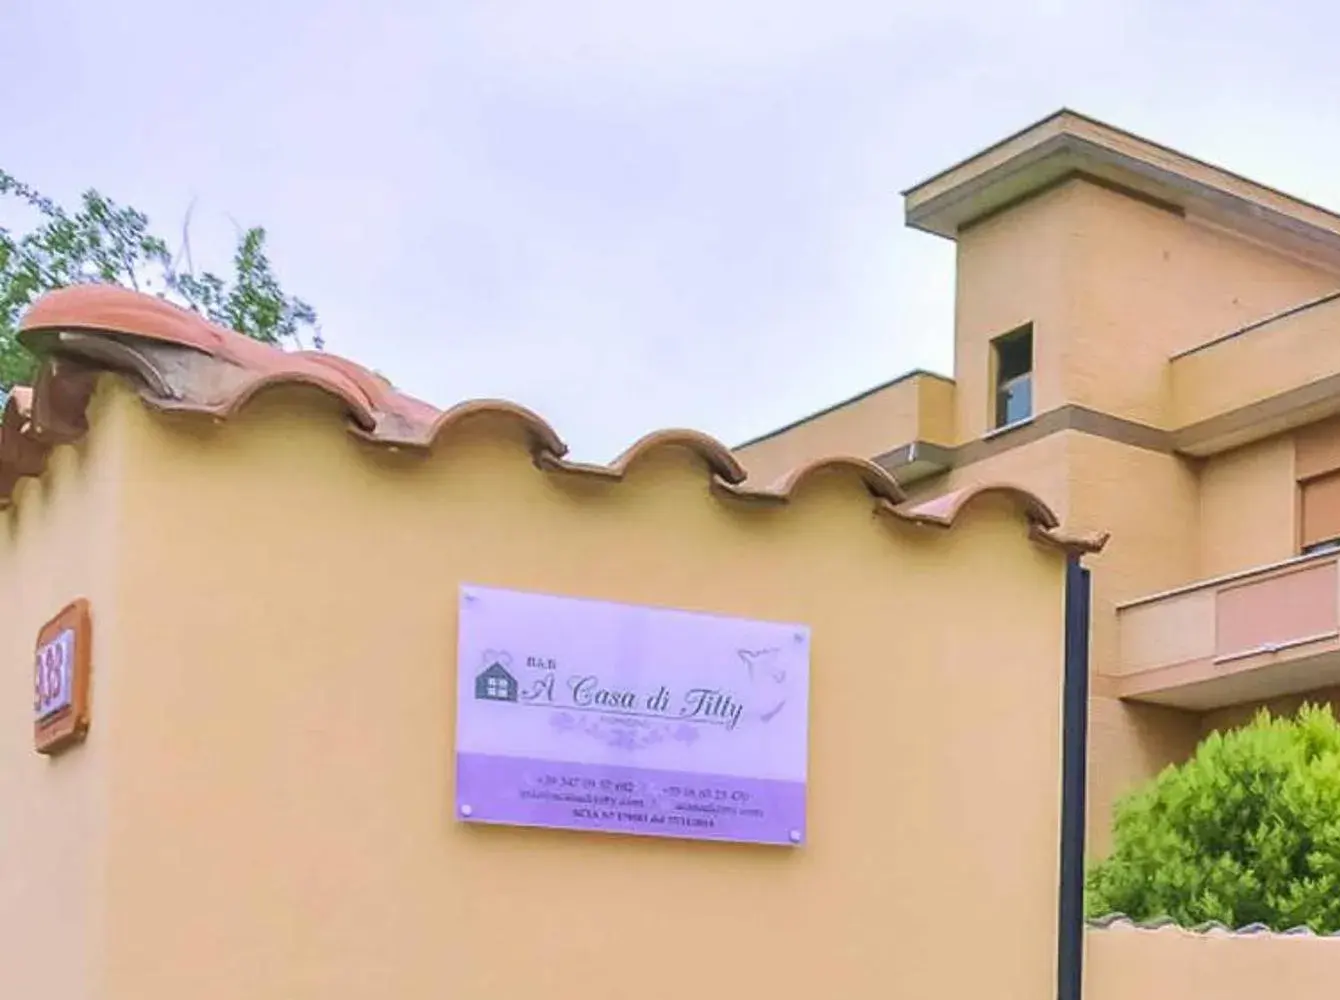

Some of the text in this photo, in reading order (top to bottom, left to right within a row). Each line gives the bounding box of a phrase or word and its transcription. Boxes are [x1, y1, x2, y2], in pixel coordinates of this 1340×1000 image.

[521, 672, 556, 702] A
[566, 675, 636, 707] Casa
[645, 685, 669, 712] di
